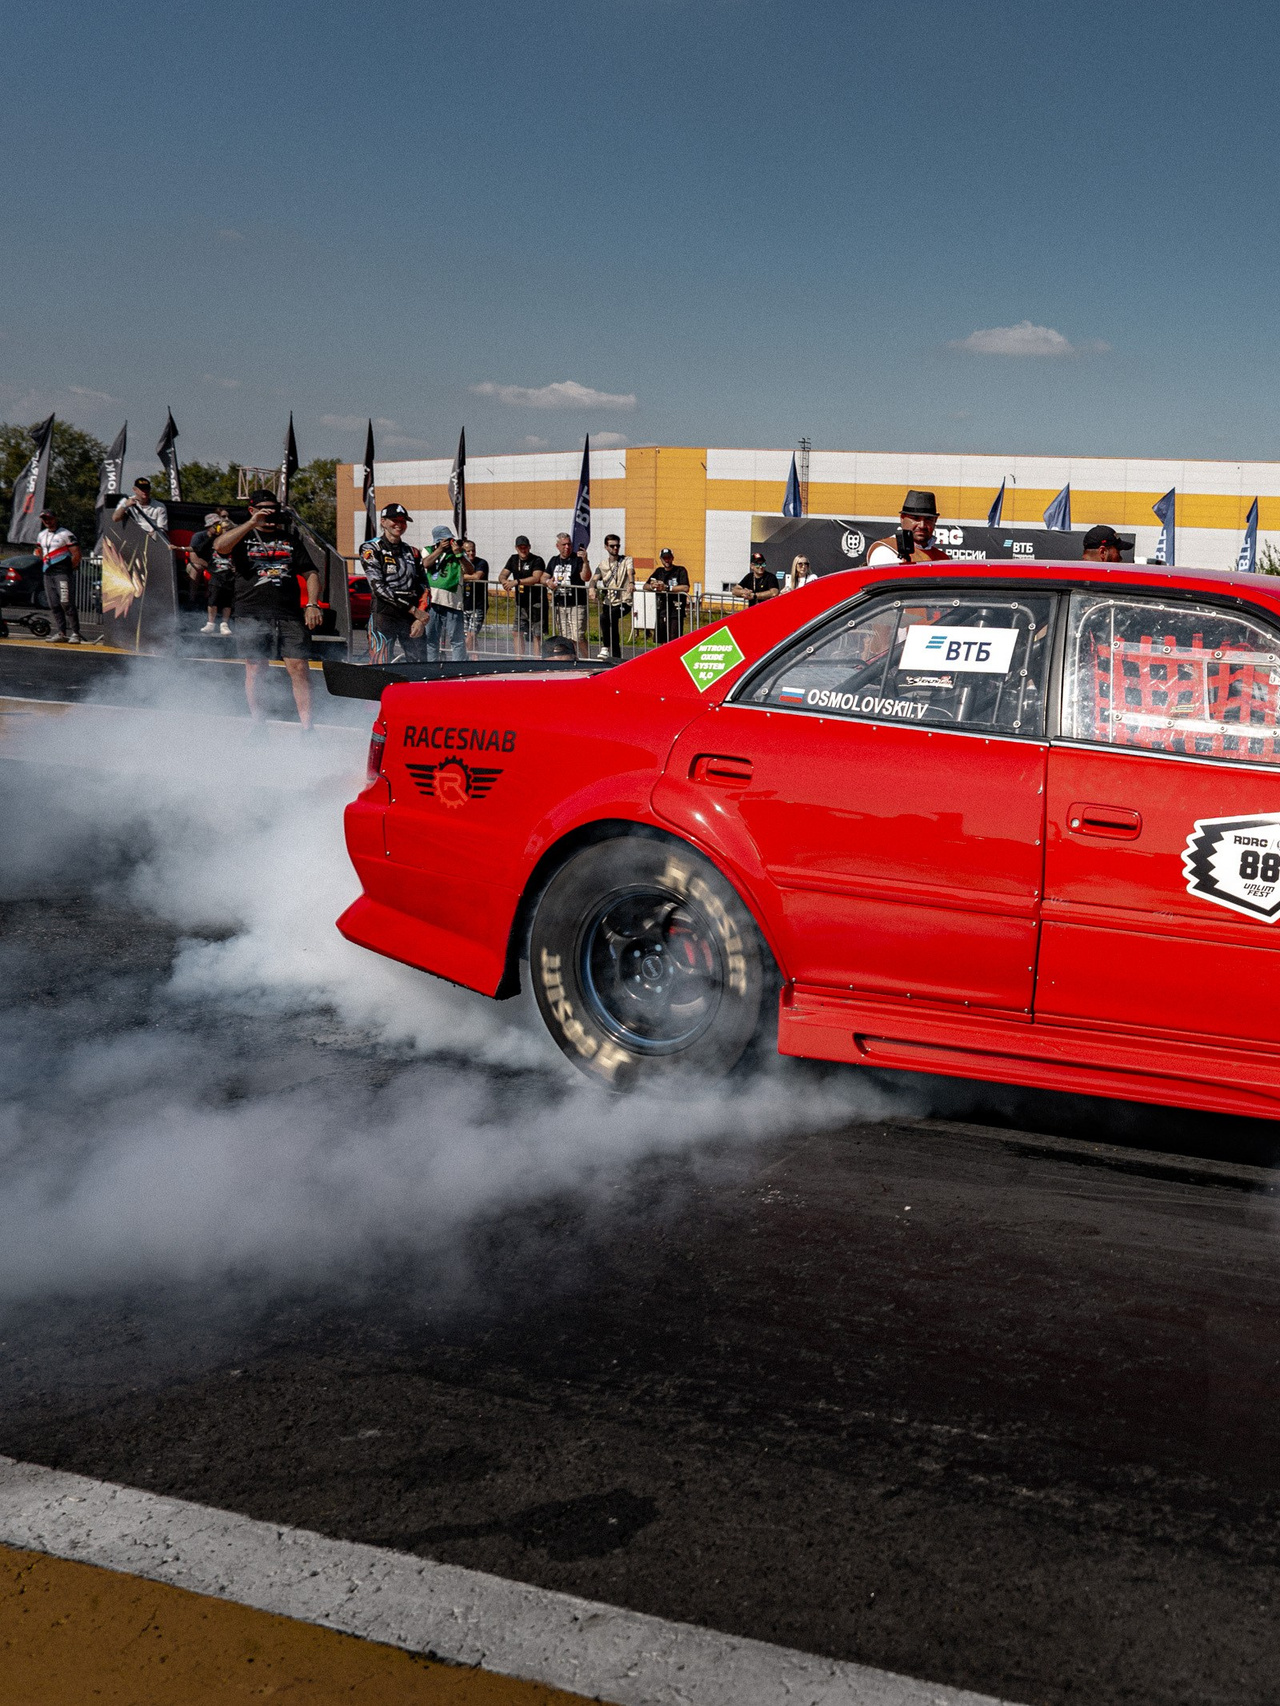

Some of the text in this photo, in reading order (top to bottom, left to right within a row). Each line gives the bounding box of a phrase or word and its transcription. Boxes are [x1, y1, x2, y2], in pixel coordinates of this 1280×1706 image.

[1012, 541, 1034, 553] ВТБ
[945, 640, 992, 662] ВТБ
[701, 653, 725, 661] OXIDE
[693, 662, 726, 670] SYSTEM
[403, 725, 517, 752] RACESNAB
[1233, 835, 1268, 848] RDRC
[1243, 882, 1275, 893] UNLIM
[1247, 889, 1271, 898] FEST
